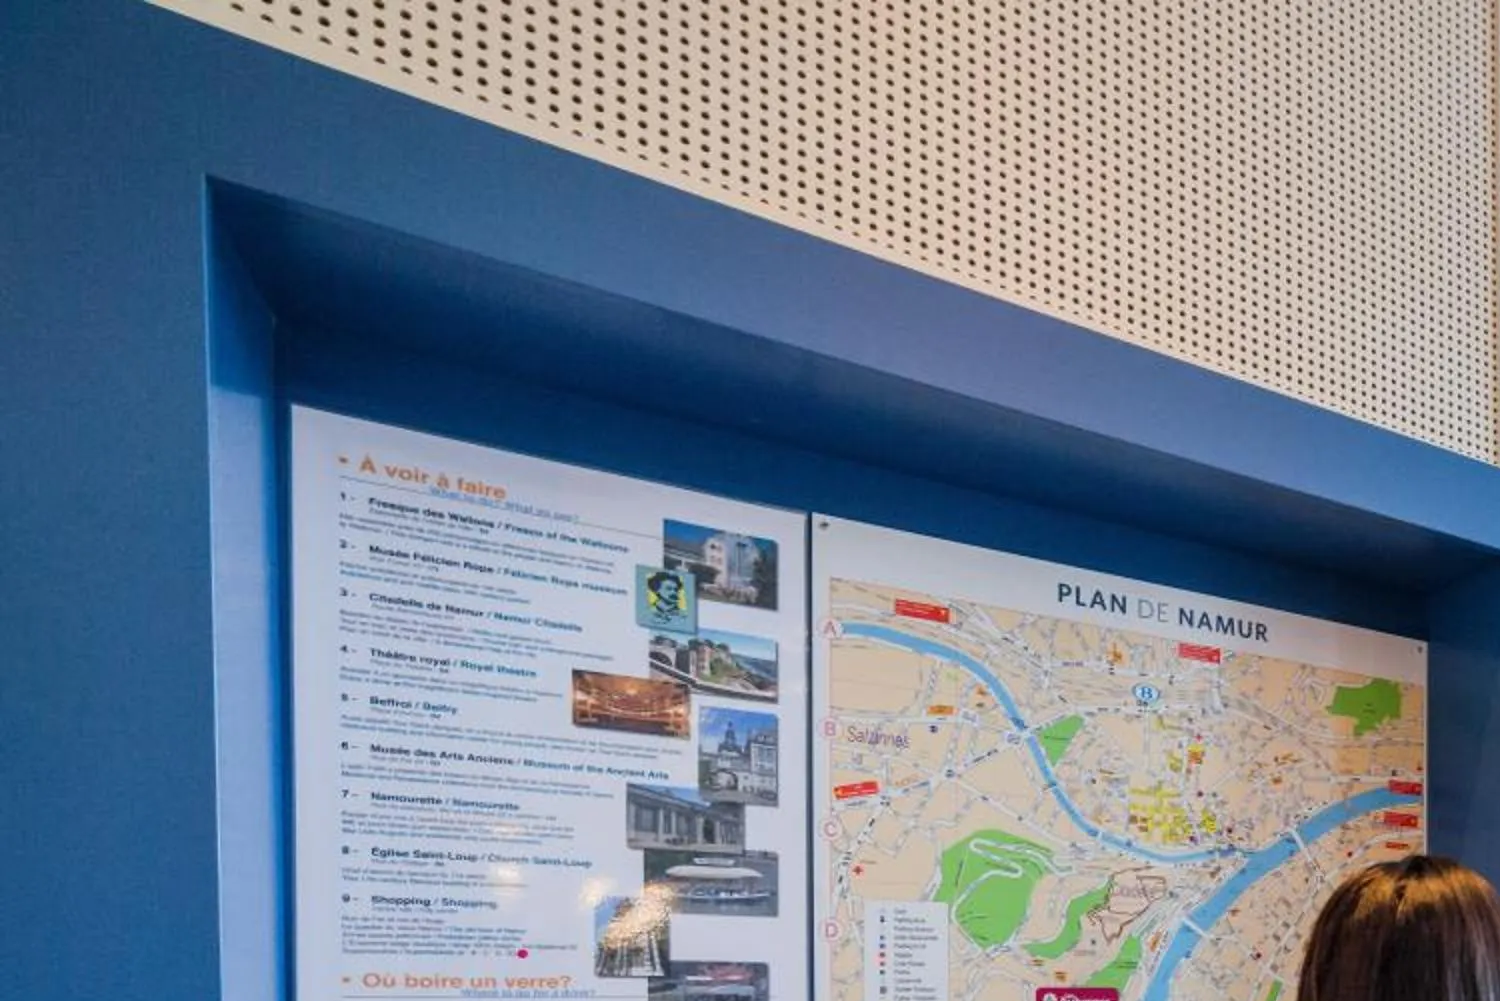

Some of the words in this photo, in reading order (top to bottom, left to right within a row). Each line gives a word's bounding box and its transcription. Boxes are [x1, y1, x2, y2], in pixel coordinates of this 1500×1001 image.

[385, 465, 430, 483] voir
[457, 477, 507, 500] faire
[1057, 583, 1127, 614] PLAN
[1137, 599, 1169, 623] DE
[1178, 608, 1269, 642] NAMUR
[825, 923, 838, 937] D
[362, 973, 395, 988] Où
[405, 974, 462, 989] boire
[470, 977, 497, 989] un
[505, 975, 572, 989] verre?
